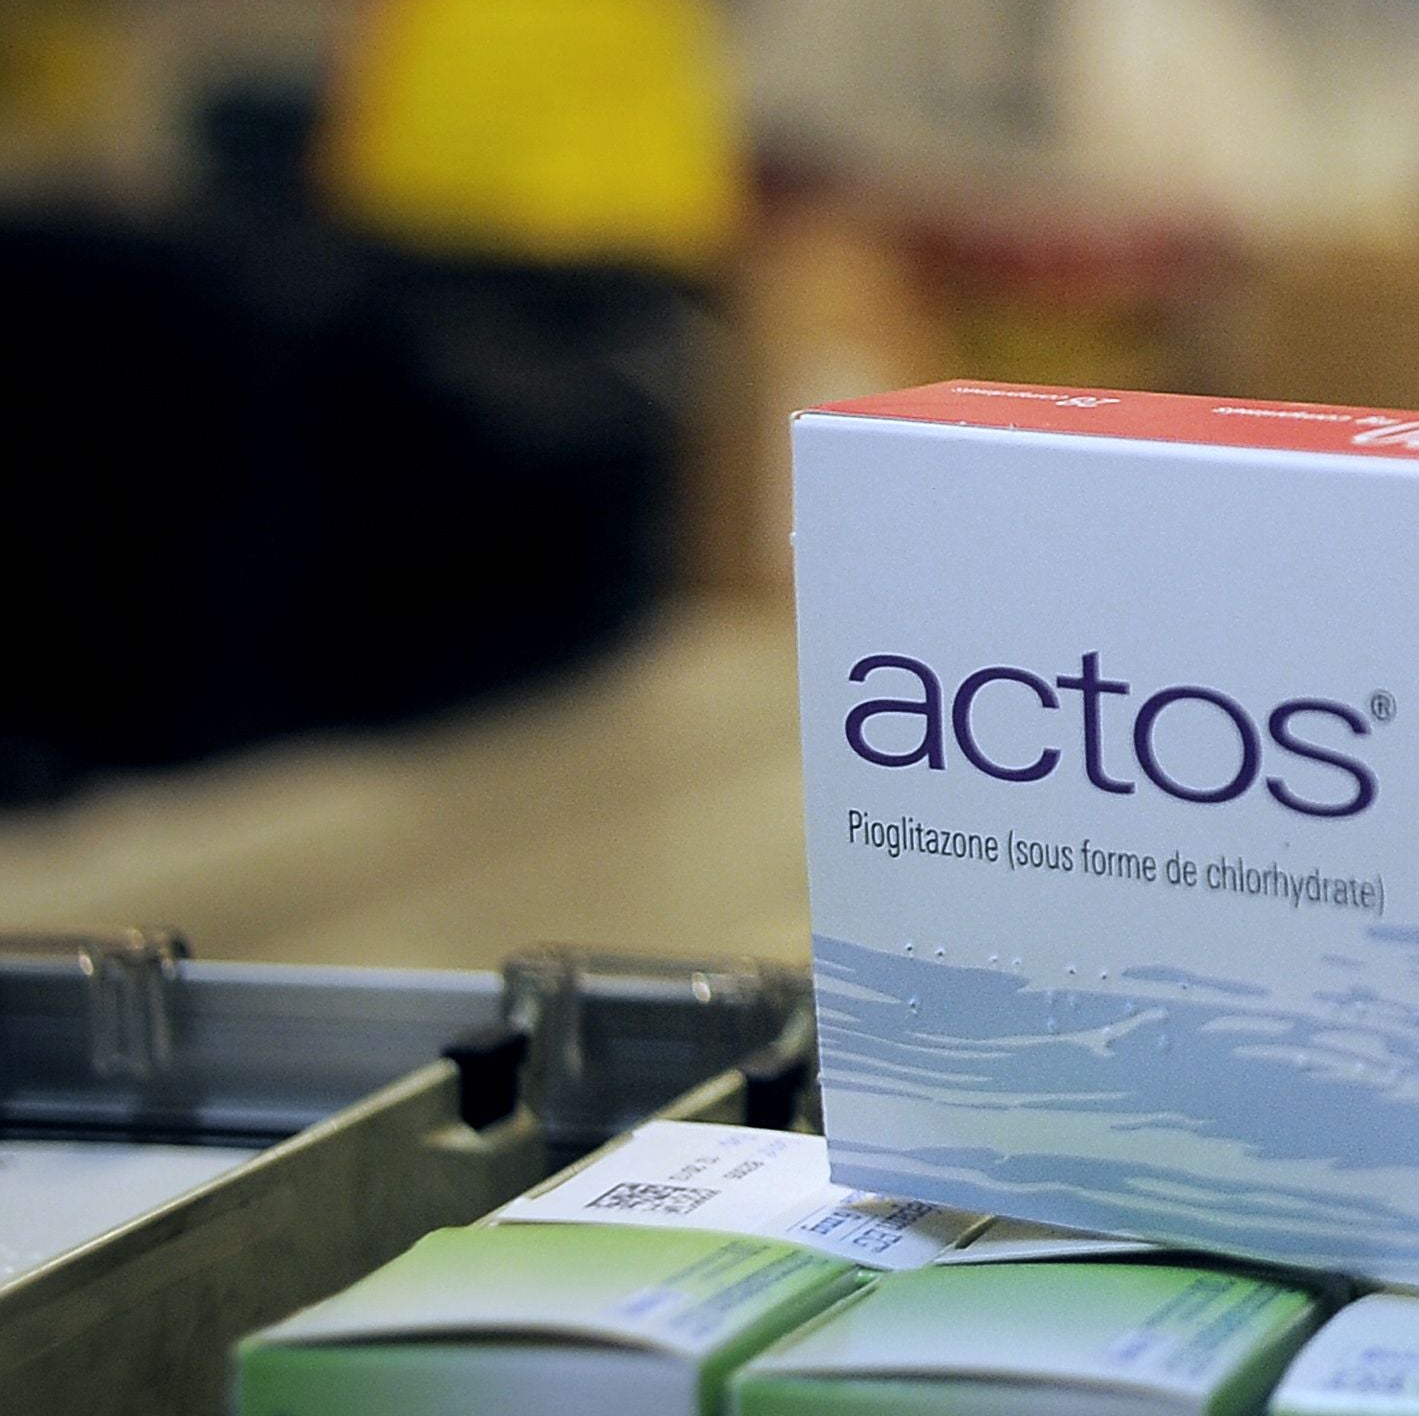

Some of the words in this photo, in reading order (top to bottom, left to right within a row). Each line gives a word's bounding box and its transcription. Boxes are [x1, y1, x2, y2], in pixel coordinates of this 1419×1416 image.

[848, 809, 999, 863] Pioglitazone
[1008, 829, 1073, 872] (sous
[1081, 838, 1156, 882] forme
[1166, 850, 1198, 887] de
[1206, 856, 1385, 916] chlorhydrate)
